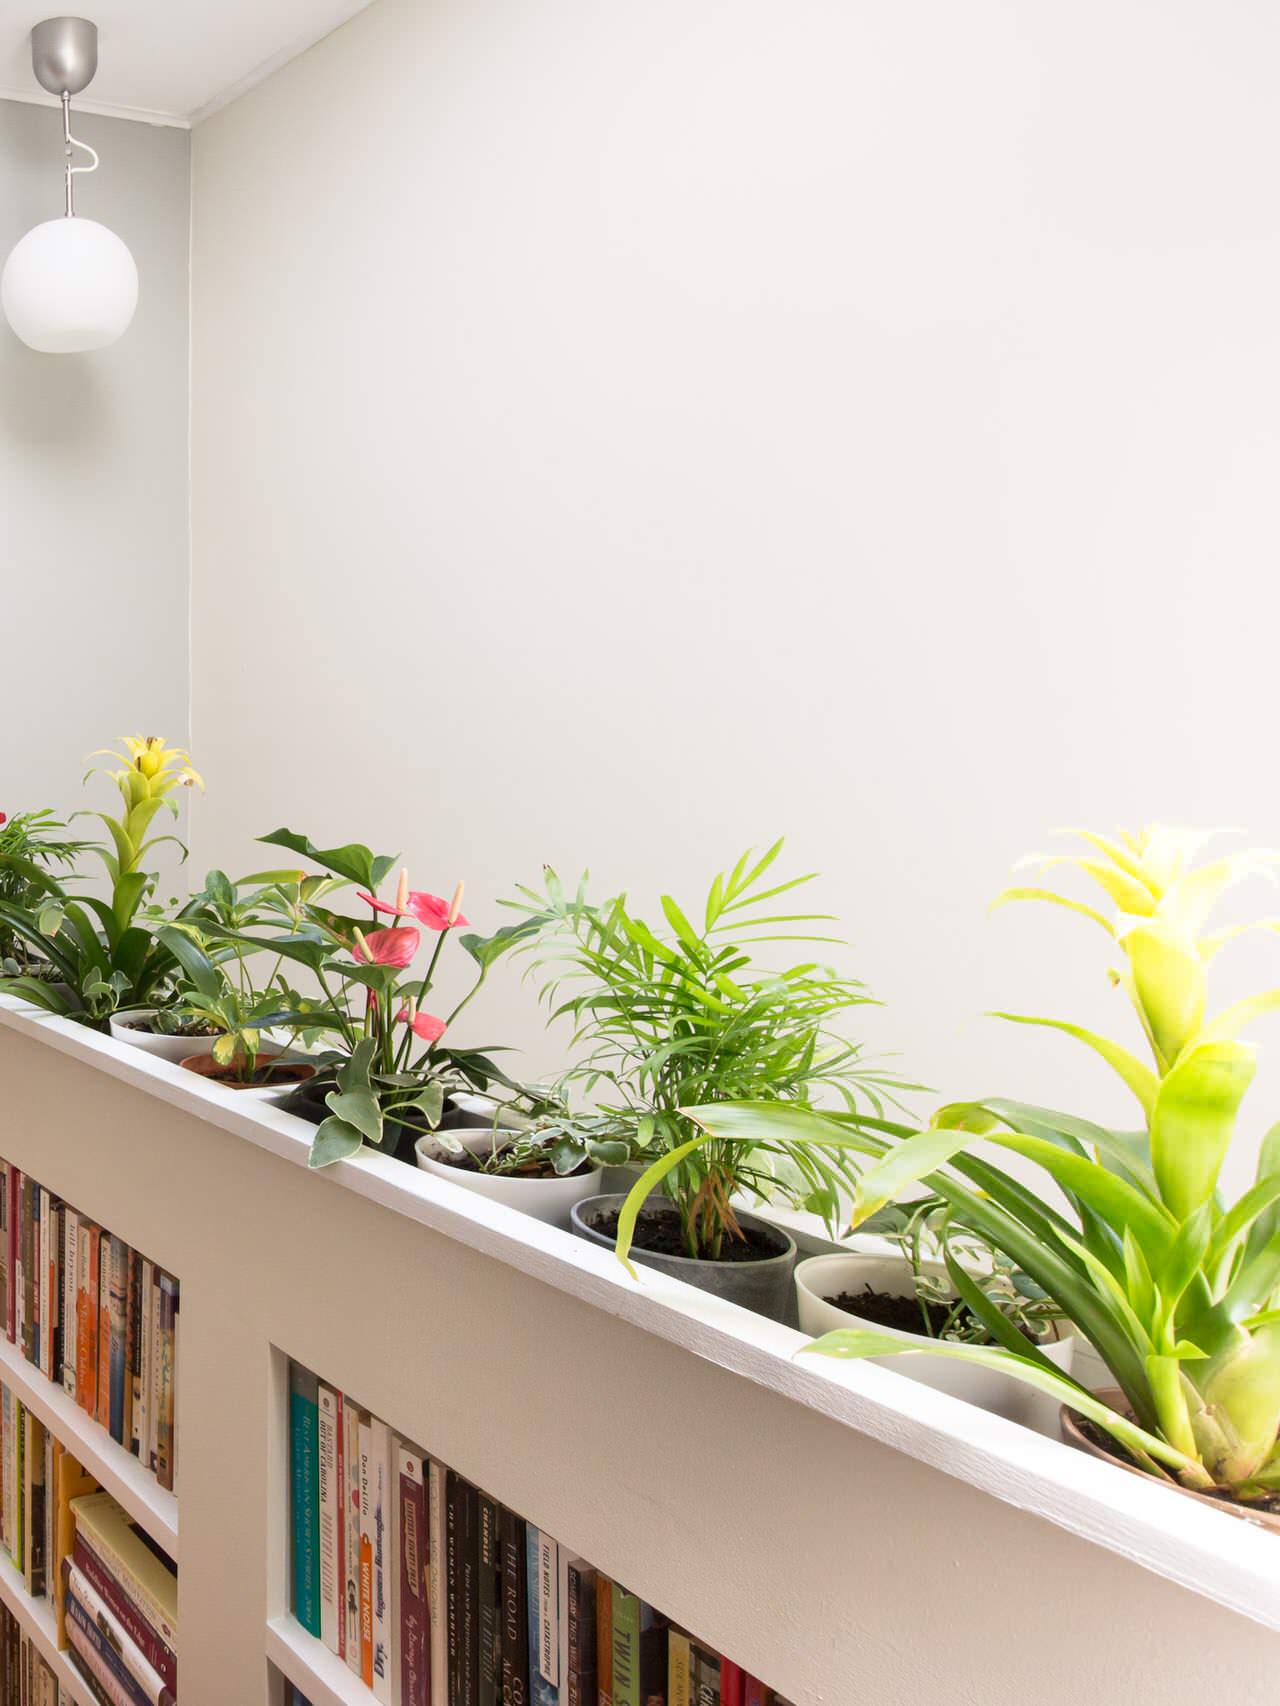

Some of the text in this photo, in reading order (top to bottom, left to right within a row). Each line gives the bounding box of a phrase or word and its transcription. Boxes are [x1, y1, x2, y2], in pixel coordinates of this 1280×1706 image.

[68, 1224, 76, 1248] bill
[67, 1249, 76, 1293] bryson
[320, 1420, 328, 1440] OUT
[326, 1423, 334, 1469] BASTARD
[320, 1455, 328, 1503] CAROLINA
[361, 1478, 369, 1516] DeLillo
[464, 1562, 472, 1588] PRIDE
[507, 1543, 517, 1641] THE ROAD
[543, 1570, 551, 1598] NOTES
[569, 1569, 577, 1617] SOMEDAY
[361, 1561, 372, 1643] WHITE NOISE
[405, 1631, 418, 1668] George
[464, 1611, 472, 1658] PREJUDICE
[544, 1619, 552, 1678] CATASTROPHE
[569, 1618, 577, 1645] THIS
[614, 1627, 631, 1689] TWIN
[513, 1677, 523, 1706] CO
